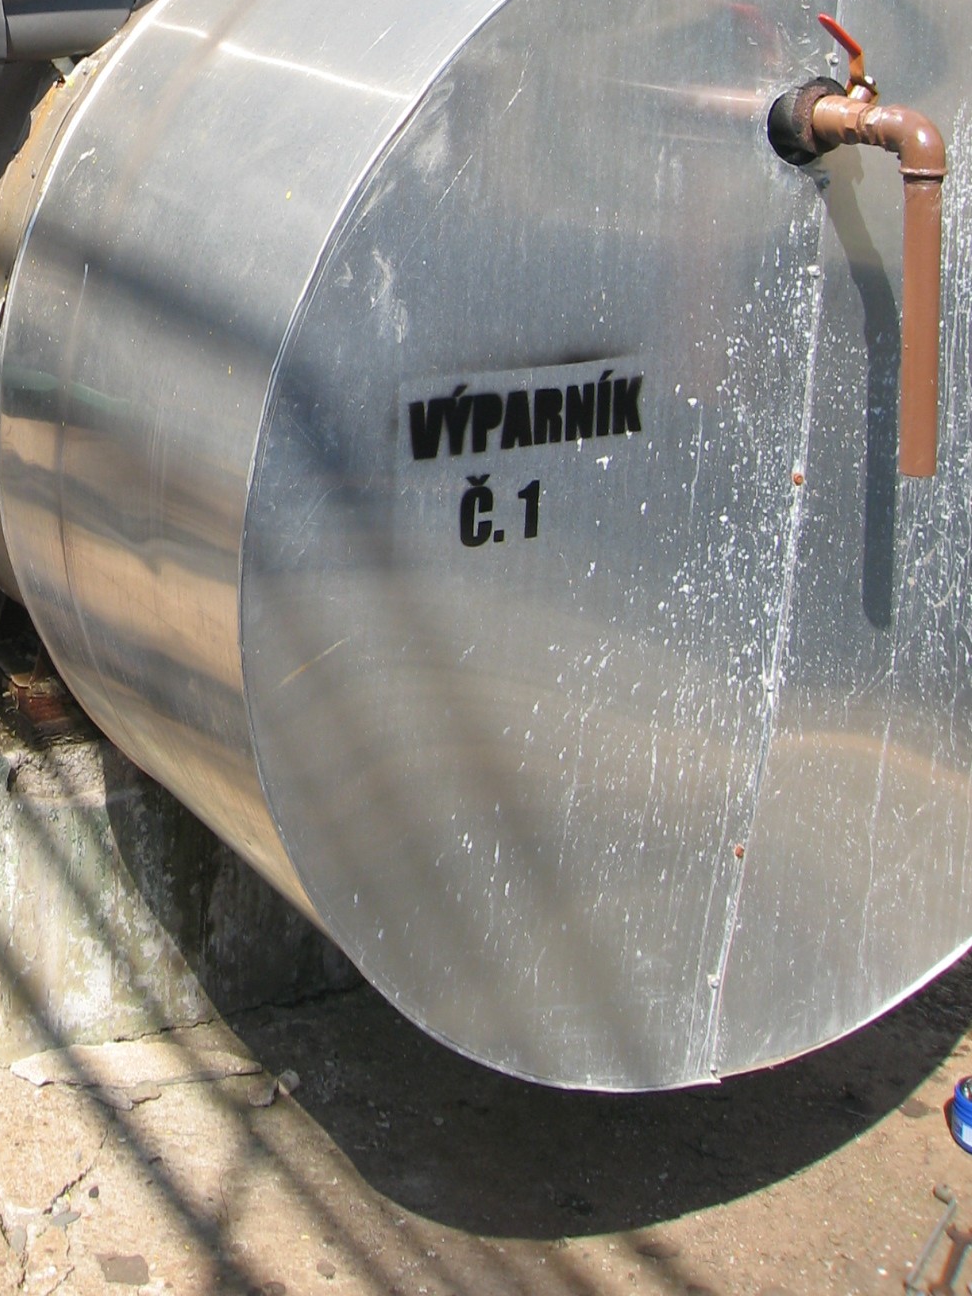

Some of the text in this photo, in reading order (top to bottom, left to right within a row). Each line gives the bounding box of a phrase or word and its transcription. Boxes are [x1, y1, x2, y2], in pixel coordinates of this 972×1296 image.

[409, 369, 643, 461] VÝPARNÍK
[460, 473, 540, 548] Č. 1
